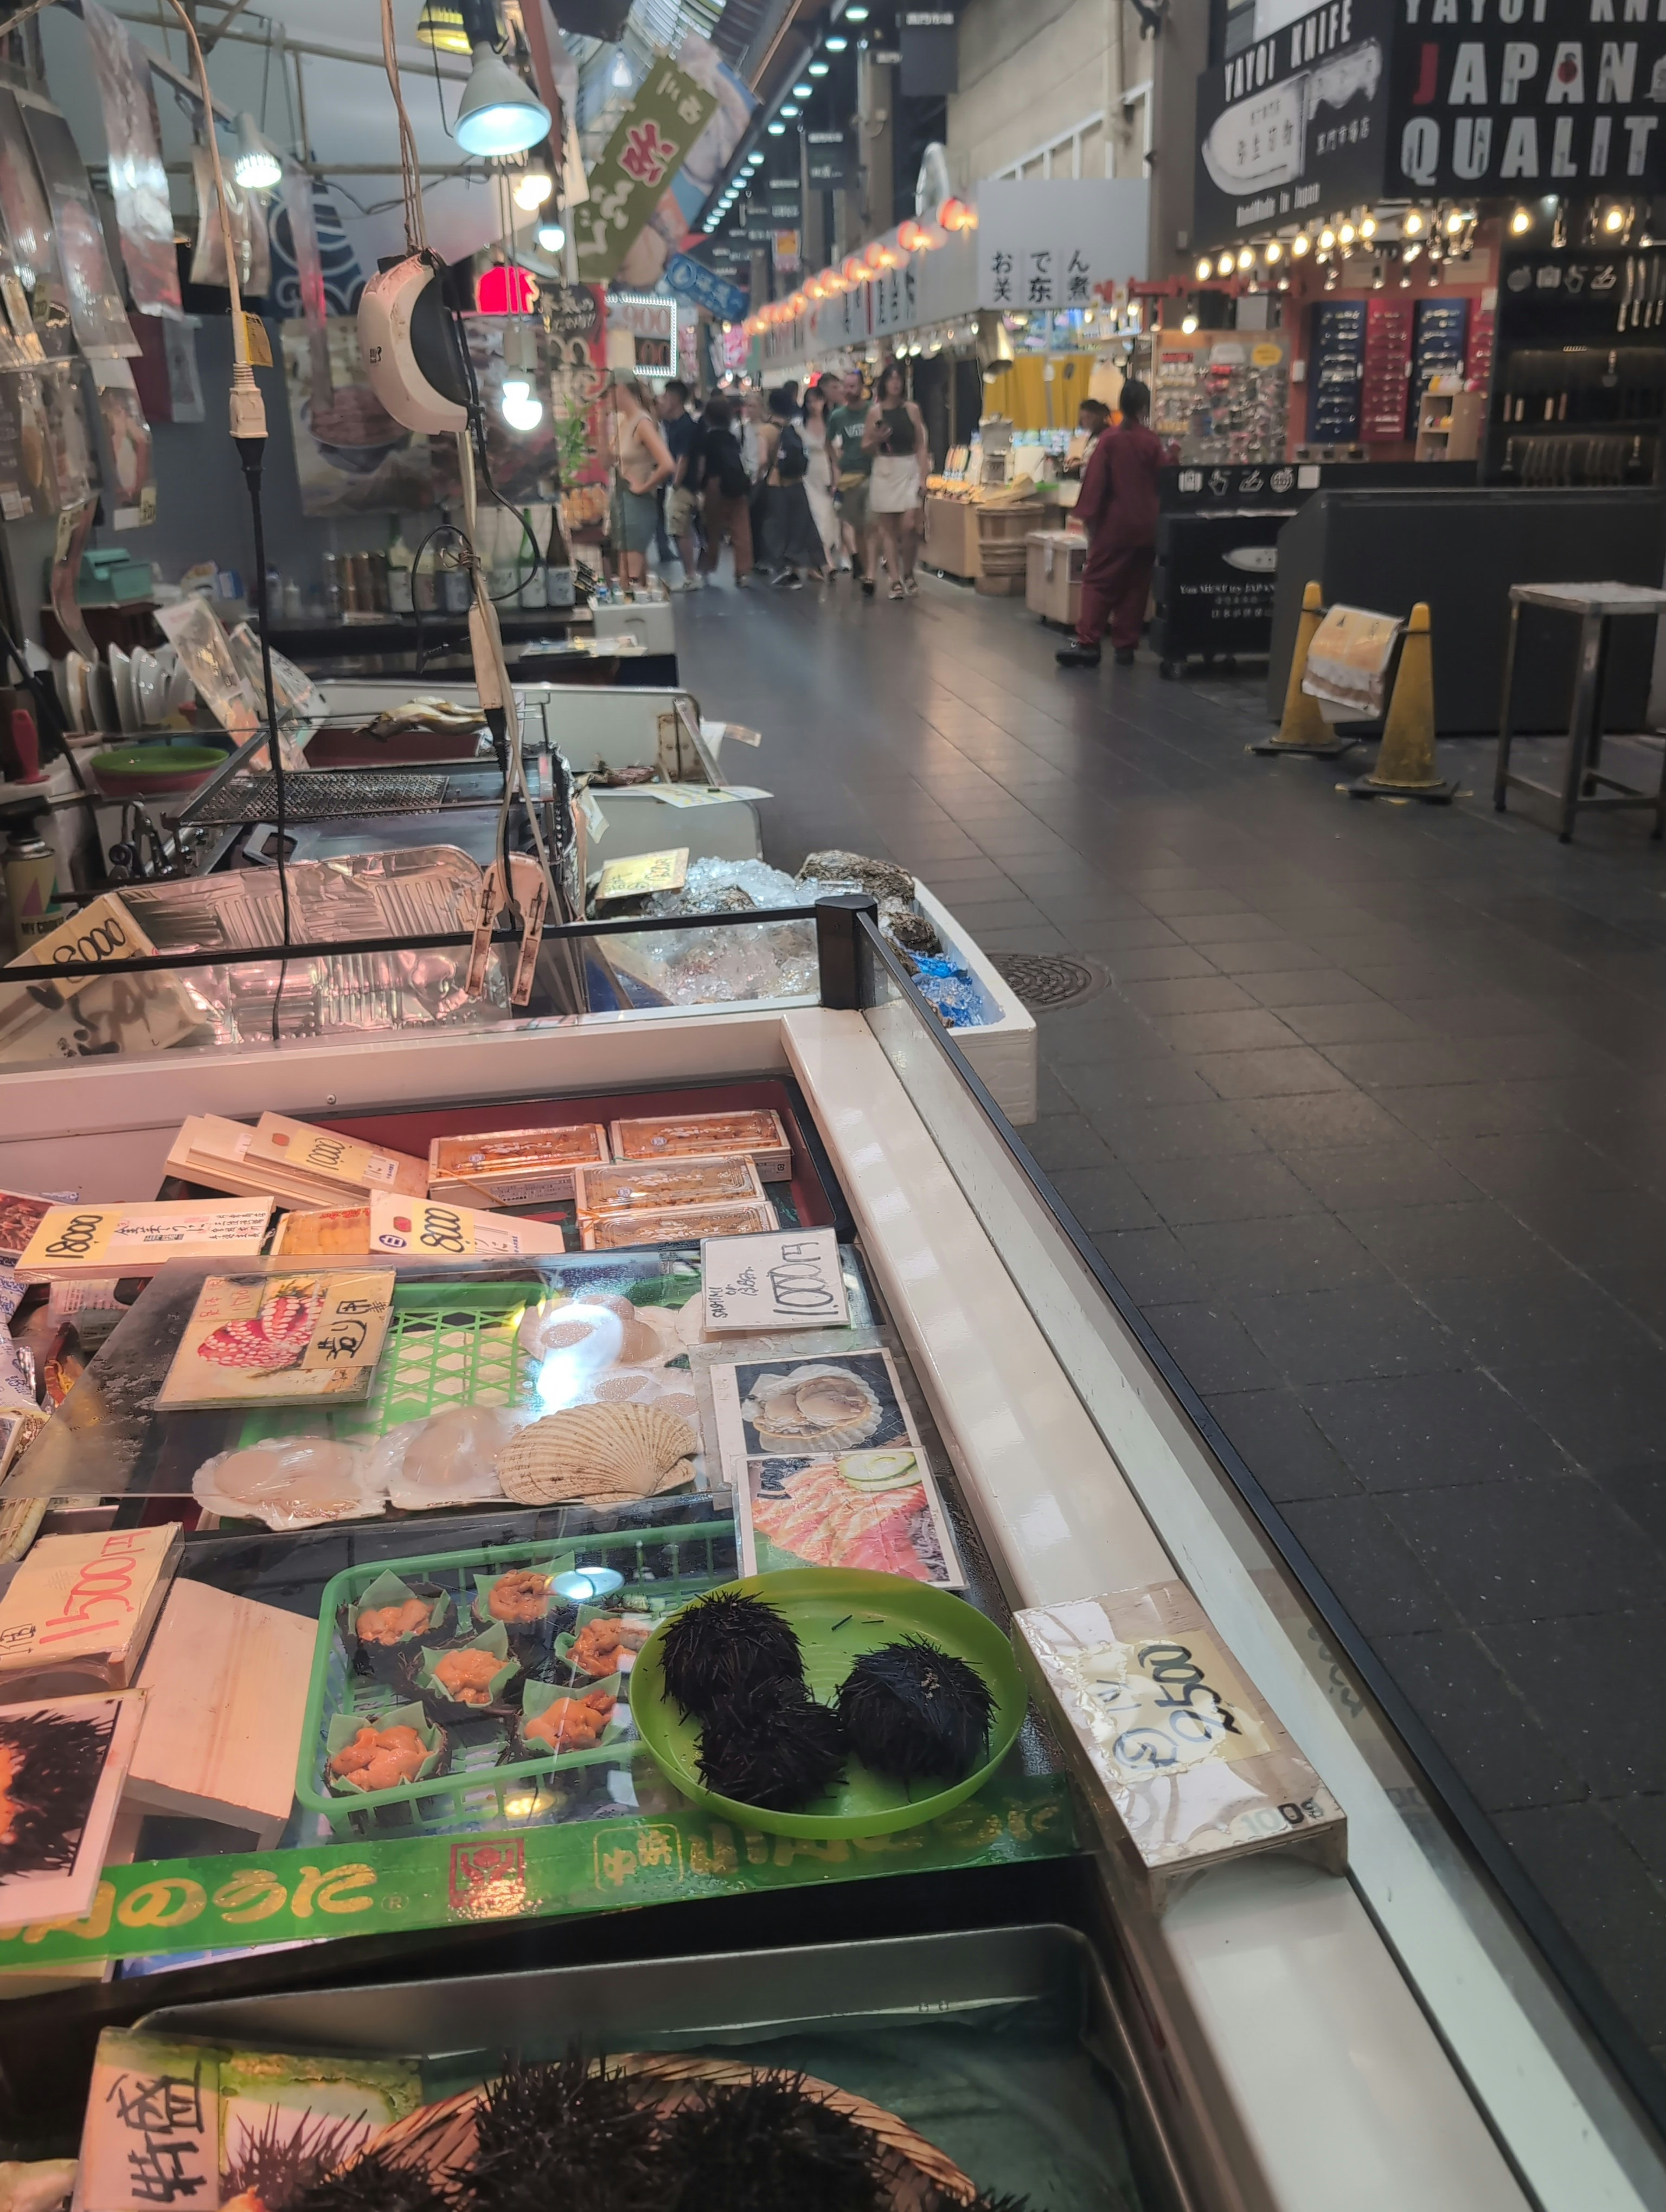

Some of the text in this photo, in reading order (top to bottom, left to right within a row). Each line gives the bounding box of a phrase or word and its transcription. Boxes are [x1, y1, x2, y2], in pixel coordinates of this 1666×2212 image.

[1225, 0, 1352, 102] YAYOI KNIFE
[1412, 41, 1638, 105] JAPAN
[1400, 115, 1659, 187] QUALIT
[992, 250, 1090, 273] おでん
[994, 277, 1091, 304] 关东煮
[708, 1286, 728, 1319] SASHIMI
